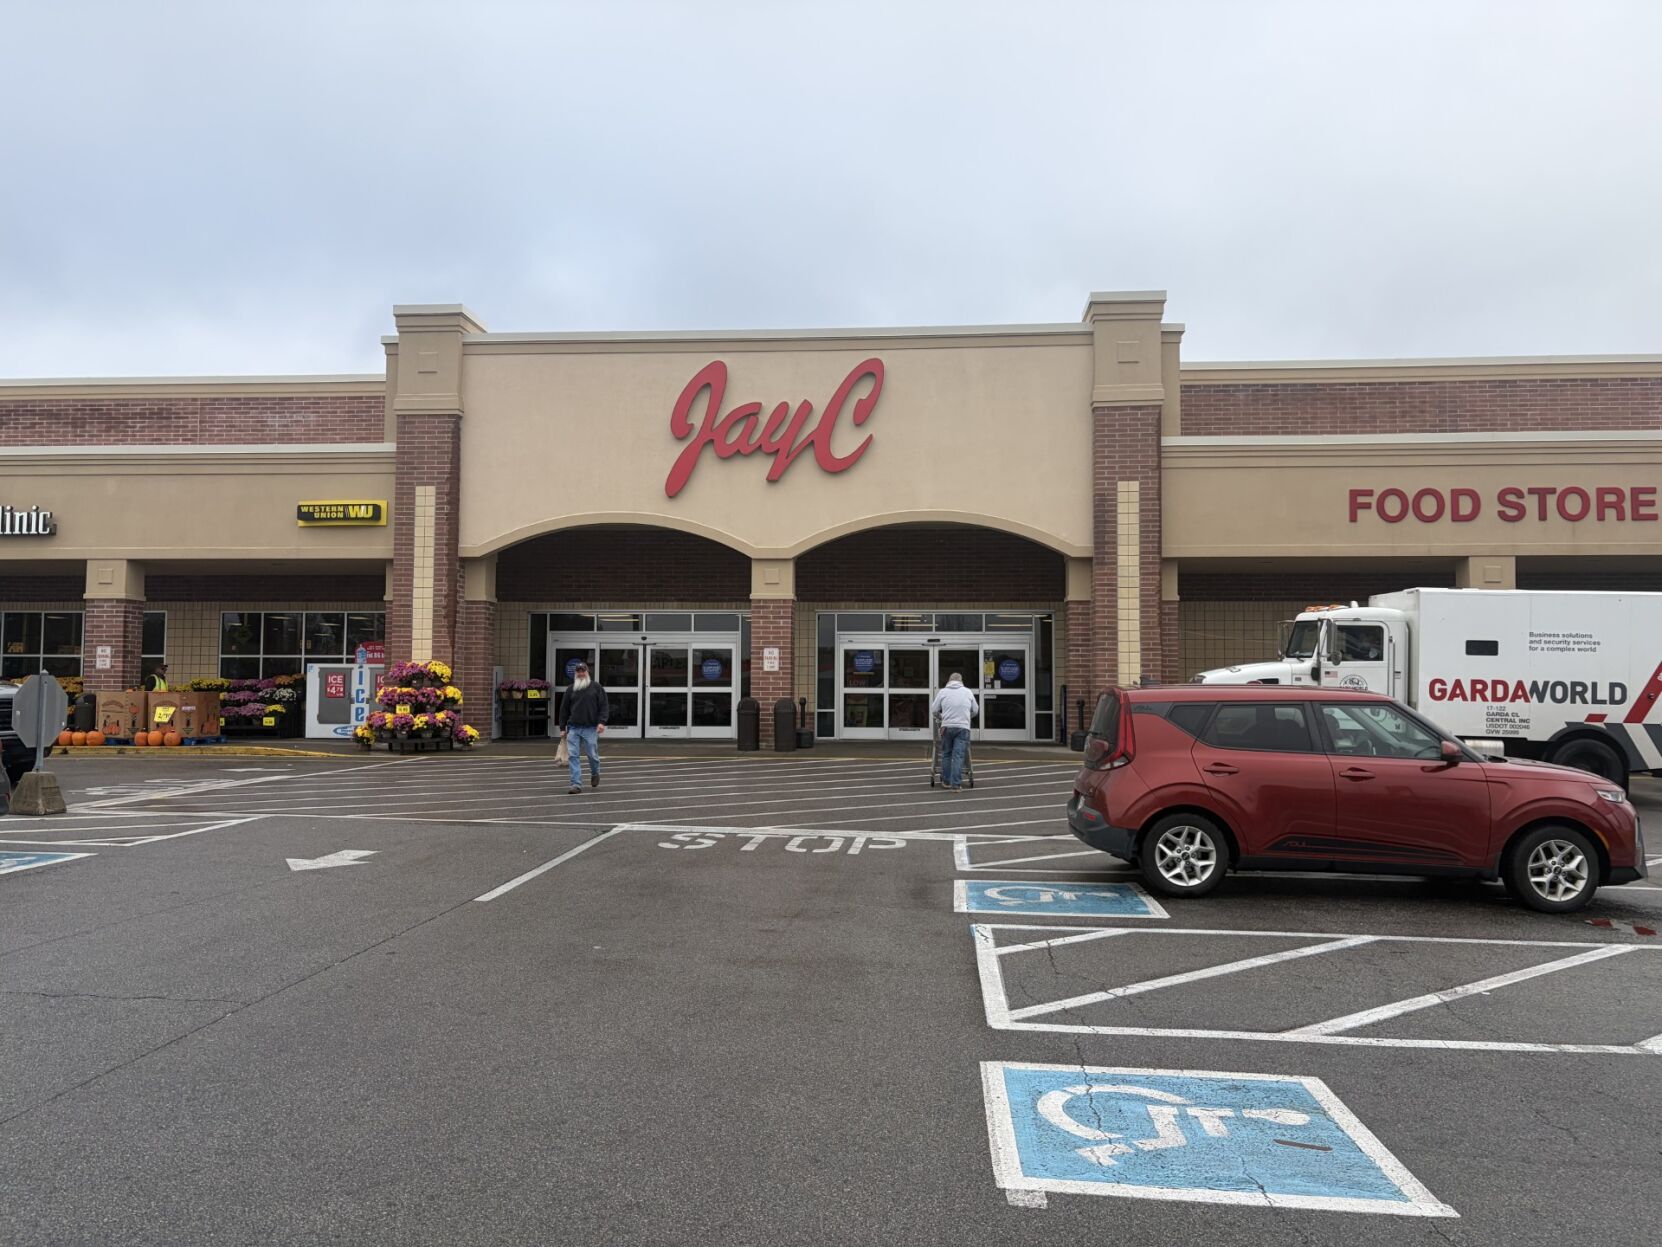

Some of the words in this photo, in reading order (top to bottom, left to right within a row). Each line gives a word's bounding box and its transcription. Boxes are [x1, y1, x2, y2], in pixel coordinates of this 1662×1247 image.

[300, 505, 344, 513] WESTERN
[348, 505, 374, 518] WU
[1348, 487, 1482, 523] FOOD
[1496, 486, 1659, 522] STORE
[328, 675, 344, 683] ICE
[1429, 678, 1628, 705] GARDAWORLD
[657, 832, 907, 855] STOP
